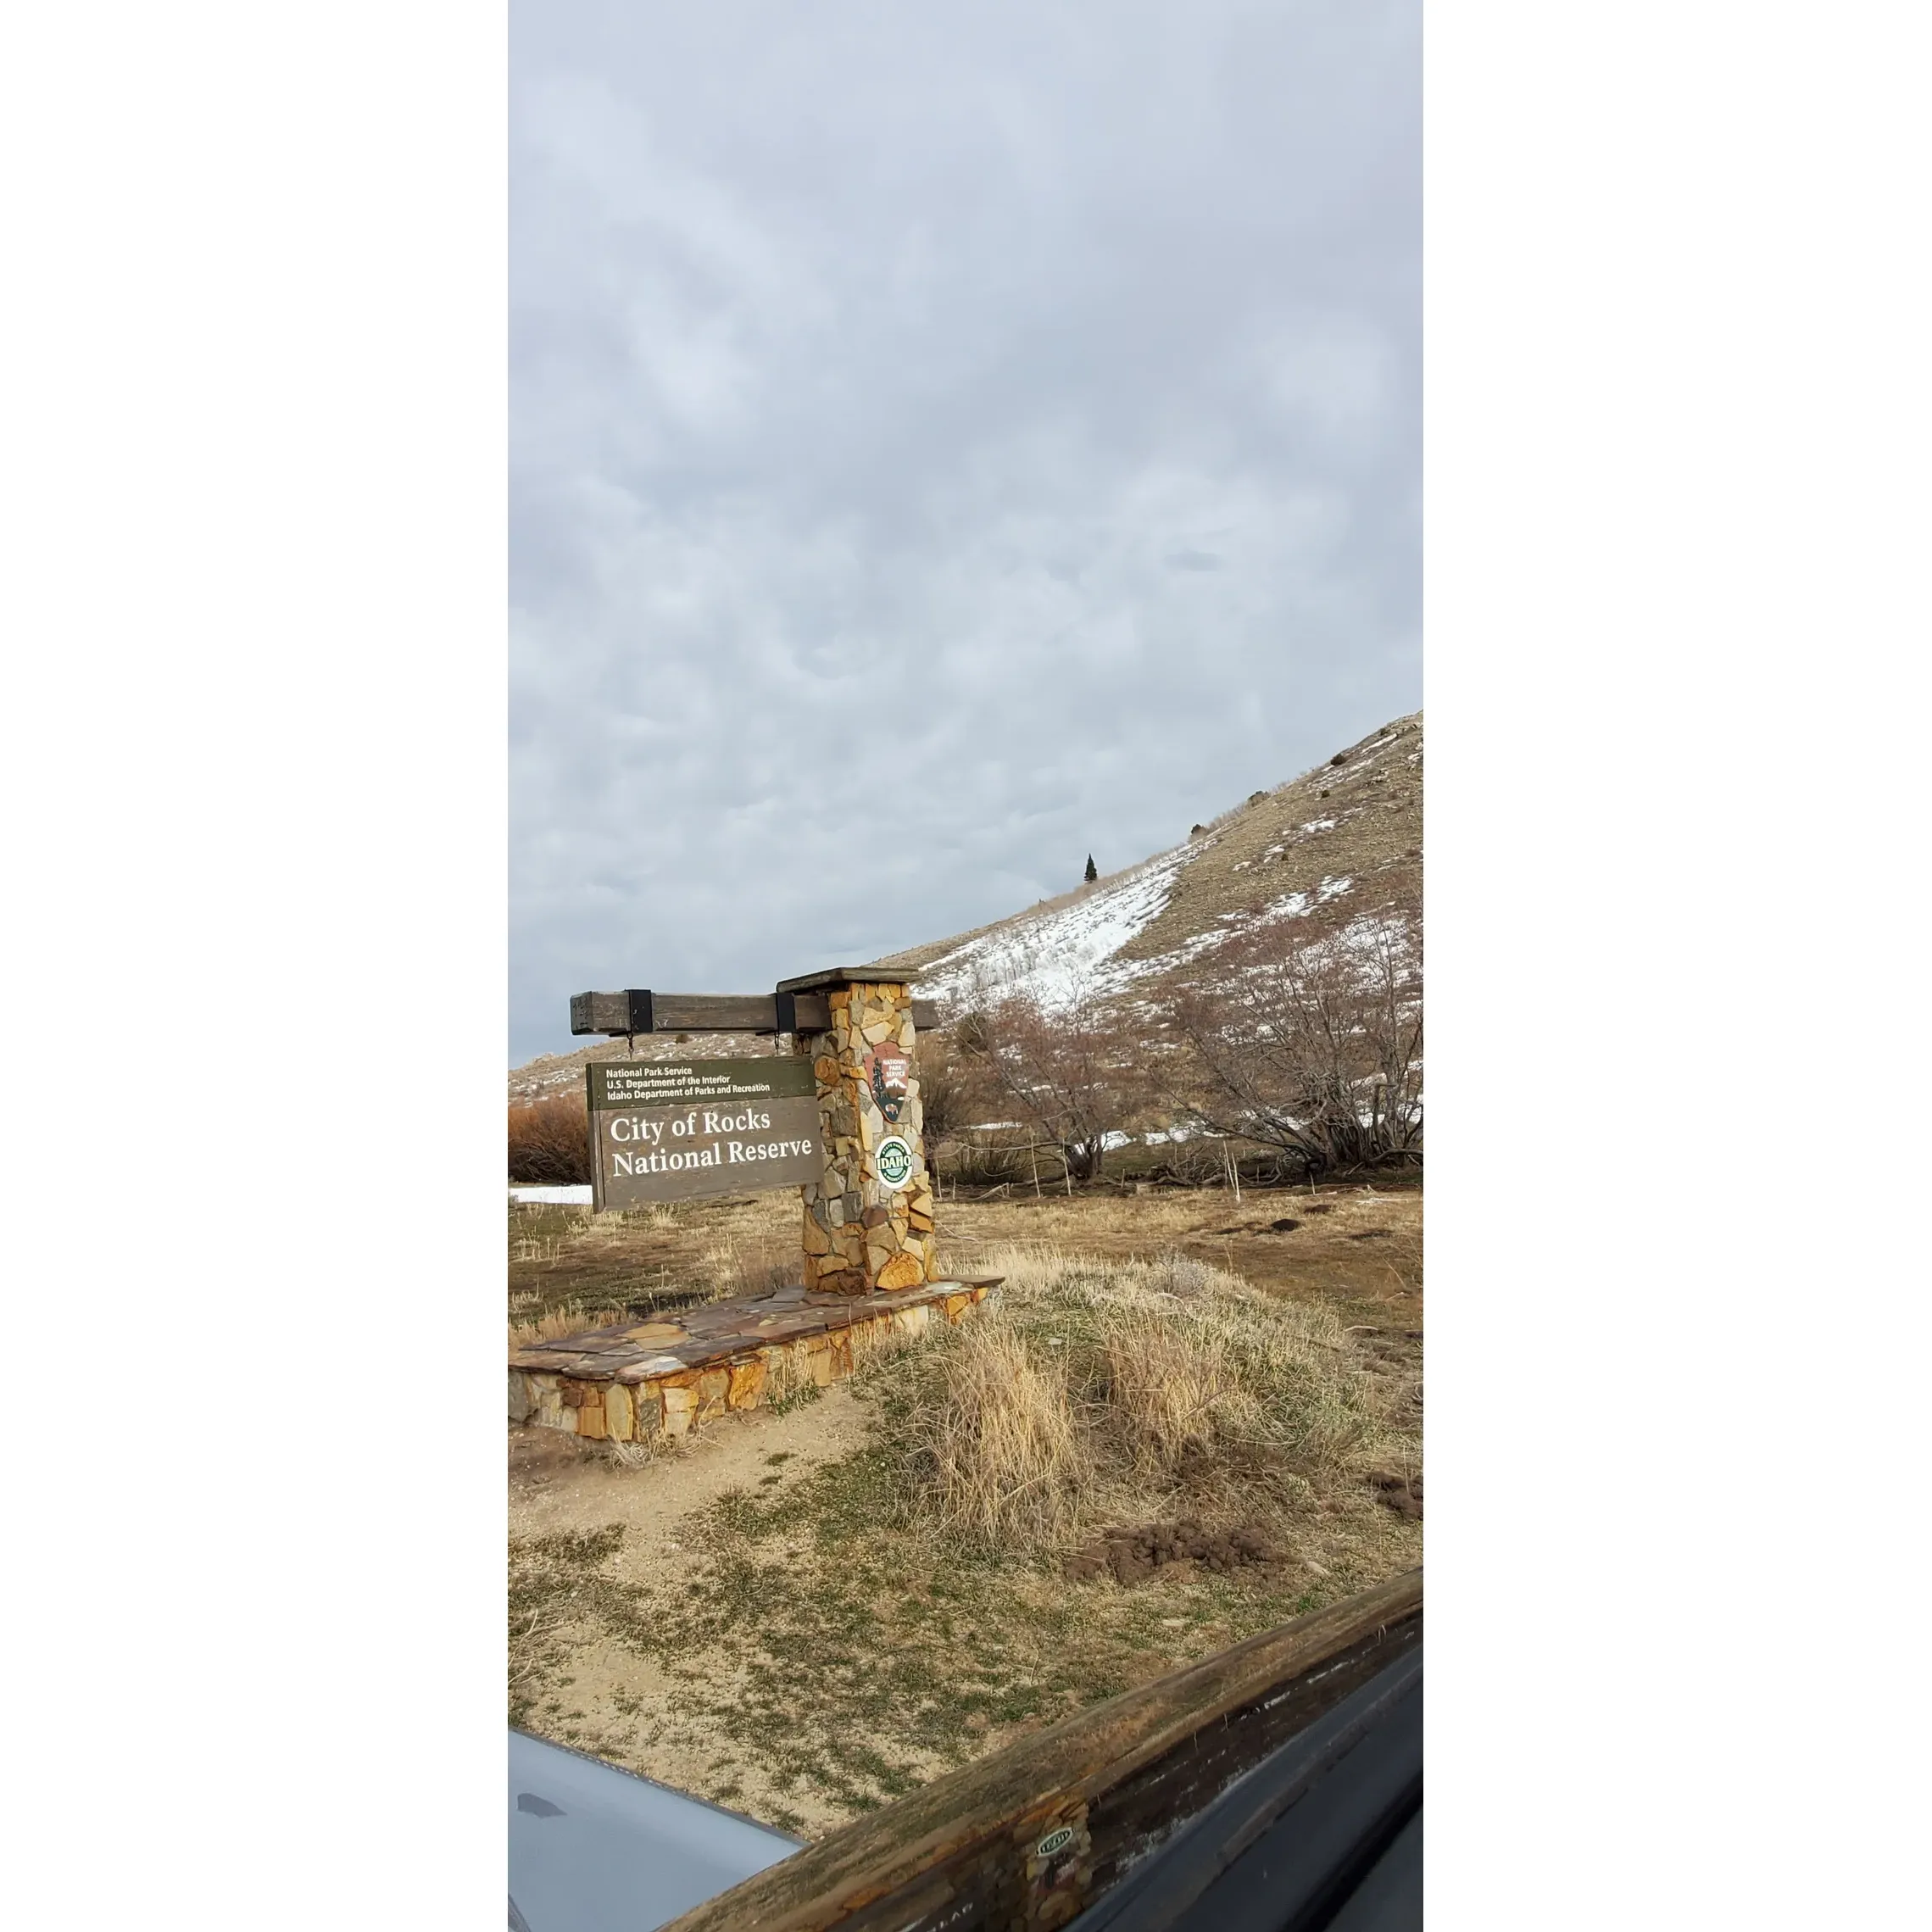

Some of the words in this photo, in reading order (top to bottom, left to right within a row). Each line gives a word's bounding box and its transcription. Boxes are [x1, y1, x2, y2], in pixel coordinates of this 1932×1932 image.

[606, 1067, 643, 1078] National
[644, 1067, 662, 1077] Park
[664, 1066, 693, 1076] Service
[606, 1080, 624, 1089] U.S.
[626, 1077, 675, 1089] Department
[676, 1077, 686, 1086] of
[688, 1076, 700, 1085] the
[702, 1075, 731, 1084] Interior
[607, 1090, 632, 1100] Idaho
[634, 1088, 683, 1100] Department
[684, 1087, 693, 1095] of
[694, 1086, 715, 1095] Parks
[716, 1084, 731, 1094] and
[732, 1083, 771, 1094] Recreation
[610, 1116, 664, 1145] City
[671, 1111, 697, 1137] of
[702, 1107, 771, 1134] Rocks
[612, 1142, 721, 1177] National
[727, 1139, 812, 1164] Reserve
[877, 1155, 911, 1170] IDAHO
